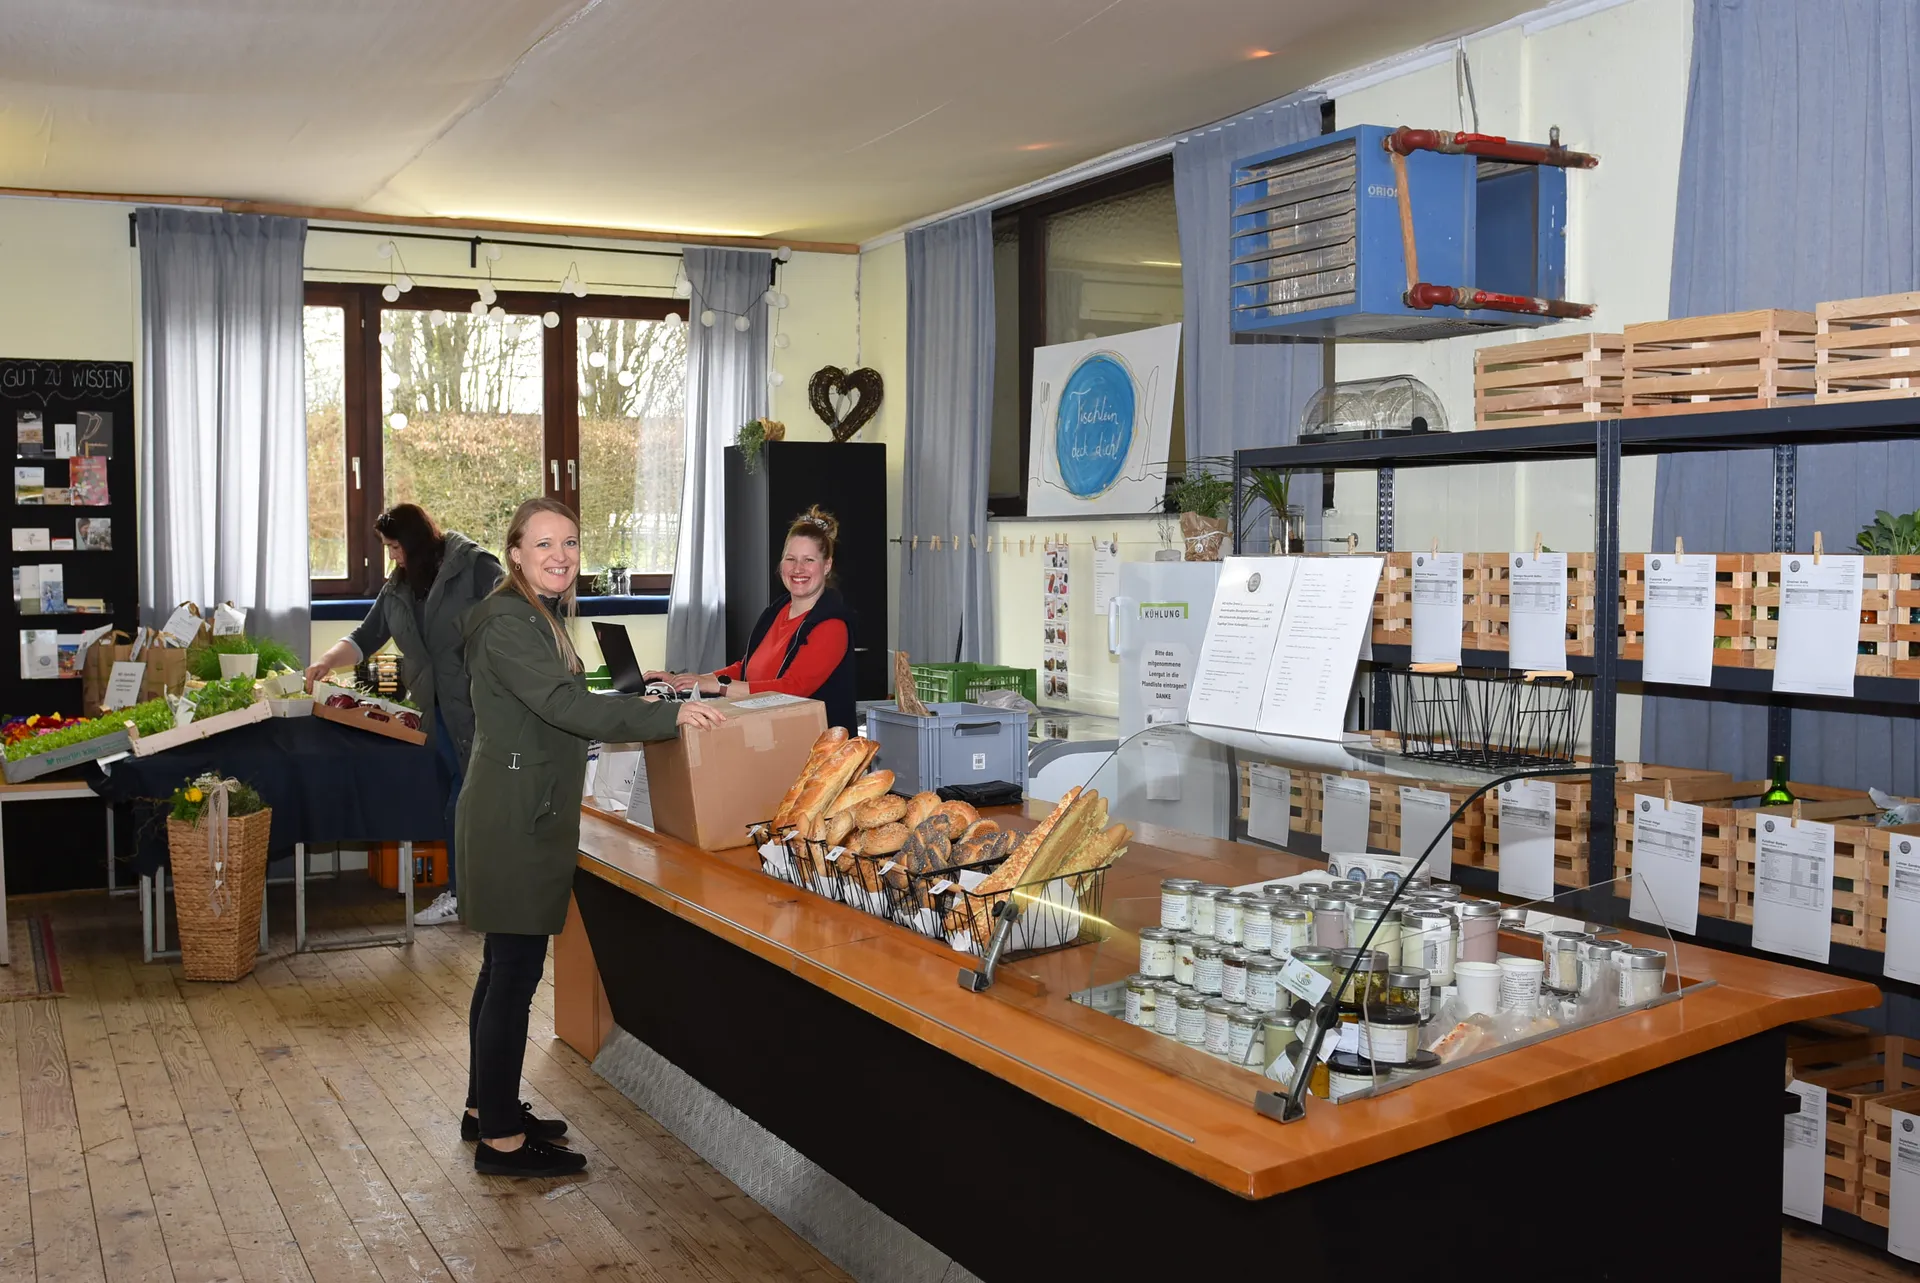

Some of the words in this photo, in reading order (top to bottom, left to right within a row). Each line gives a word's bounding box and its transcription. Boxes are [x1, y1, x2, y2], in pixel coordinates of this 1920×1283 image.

[3, 368, 37, 387] GUT
[45, 368, 61, 386] ZU
[72, 369, 123, 388] WISSEN
[1069, 388, 1119, 430] Tischlein
[1144, 609, 1181, 619] KÜHLUNG
[1155, 692, 1172, 700] DANKE
